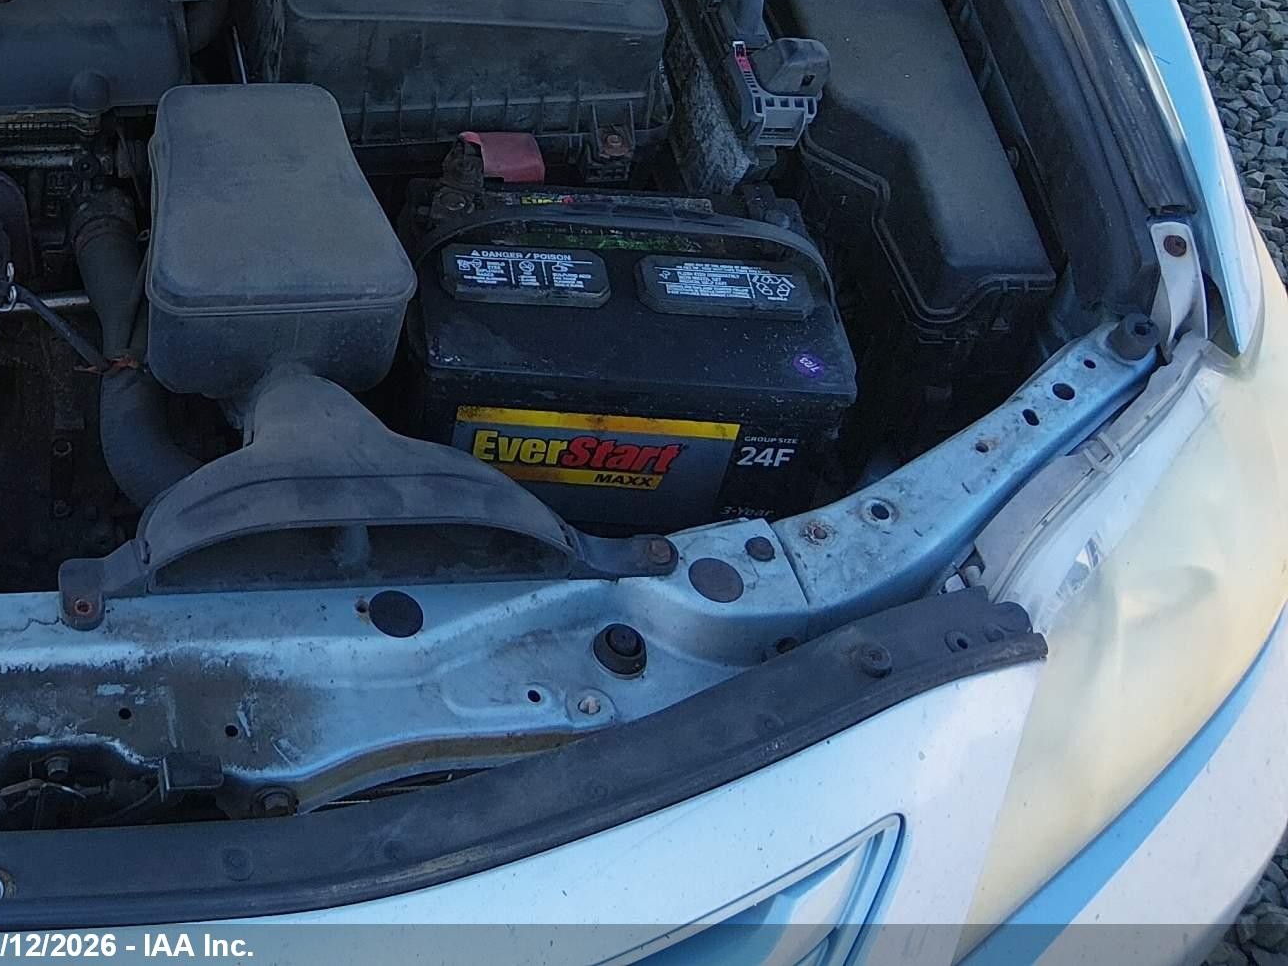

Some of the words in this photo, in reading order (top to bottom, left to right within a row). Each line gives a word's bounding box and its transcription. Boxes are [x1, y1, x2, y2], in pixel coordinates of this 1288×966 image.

[481, 250, 524, 259] DANGER
[532, 253, 572, 261] POISON
[743, 435, 777, 443] GROUP
[777, 436, 800, 445] SIZE
[472, 429, 682, 471] EverStart
[735, 446, 796, 468] 24F
[594, 472, 654, 490] MAXX
